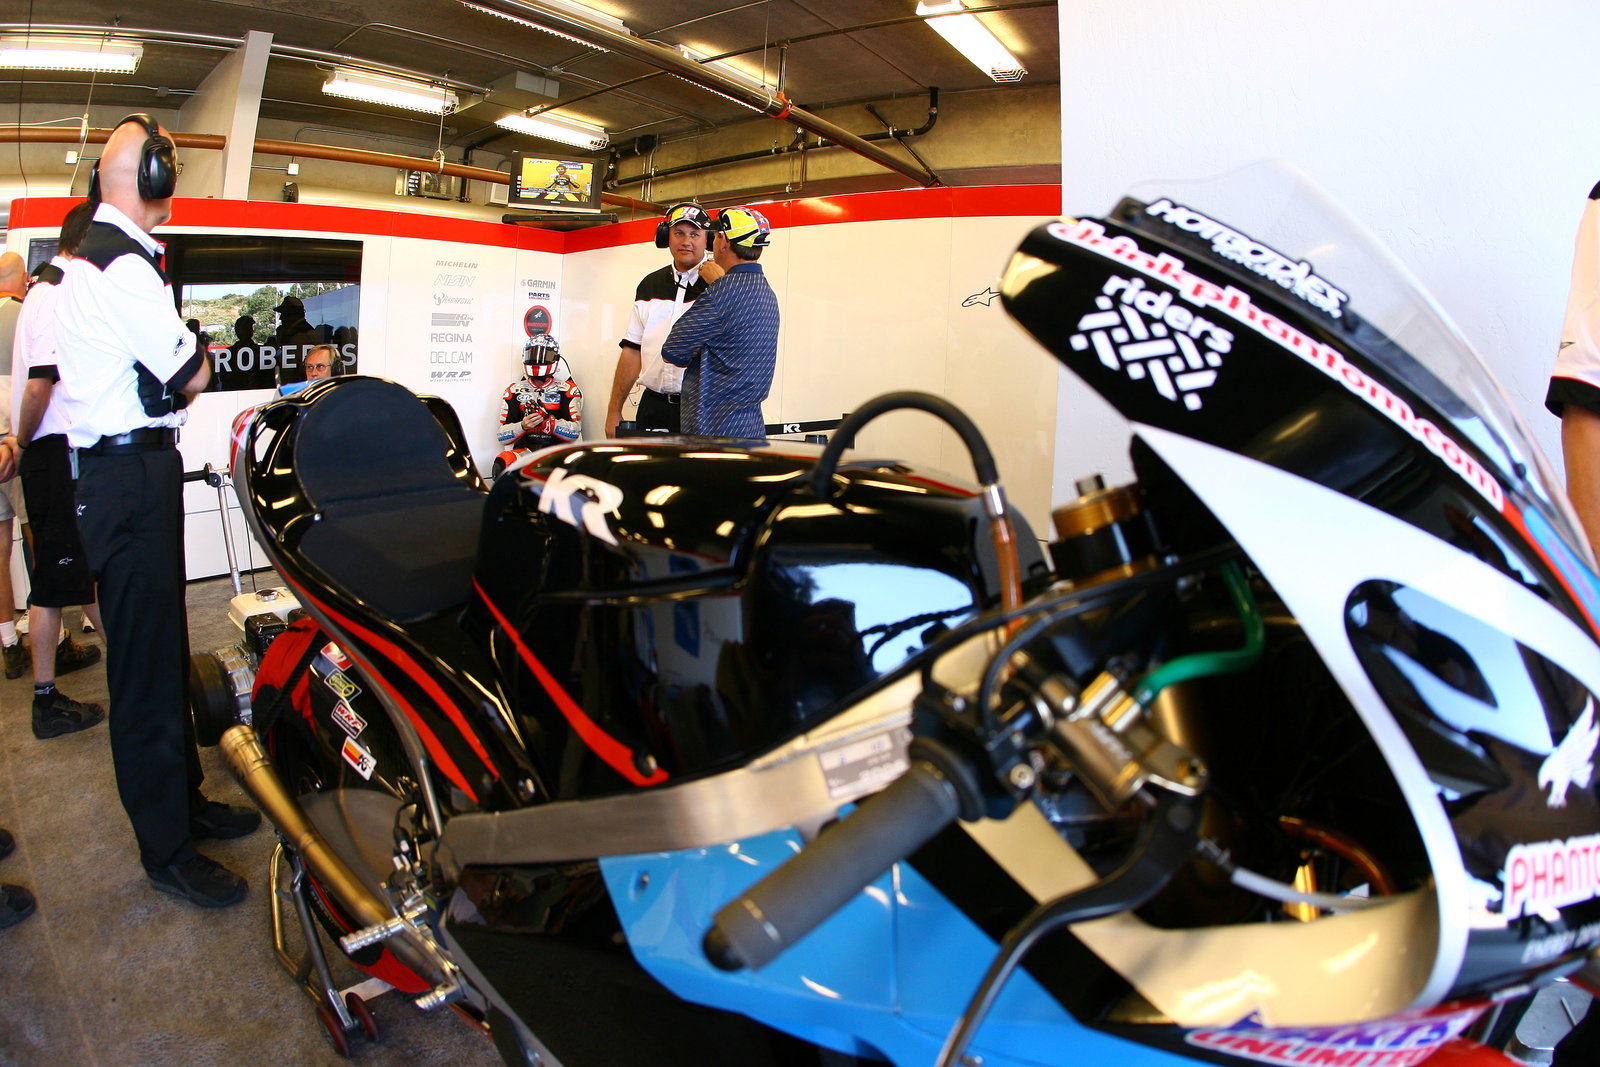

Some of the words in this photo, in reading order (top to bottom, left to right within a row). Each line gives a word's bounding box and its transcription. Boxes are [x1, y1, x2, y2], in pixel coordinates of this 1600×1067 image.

[681, 206, 700, 216] 10
[435, 260, 479, 269] MICHELIN
[527, 279, 556, 290] GARMIN
[1102, 275, 1235, 354] riders
[430, 333, 473, 343] REGINA
[214, 343, 357, 373] ROBES
[430, 351, 473, 364] DELCAM
[1048, 220, 1503, 510] drinkphantom.com
[431, 370, 472, 379] WRP
[783, 424, 802, 434] KR
[538, 467, 624, 546] KR
